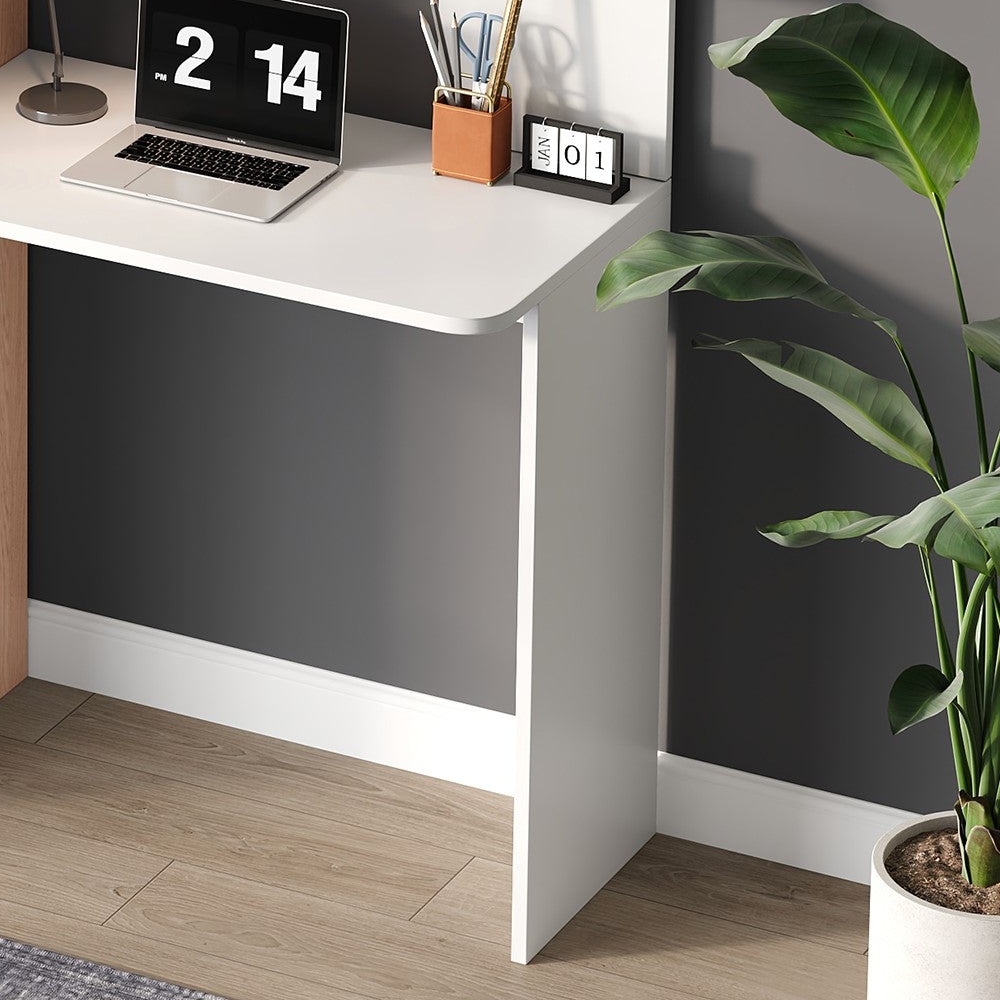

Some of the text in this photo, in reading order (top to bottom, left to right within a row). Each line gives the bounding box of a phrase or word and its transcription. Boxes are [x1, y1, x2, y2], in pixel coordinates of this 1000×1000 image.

[155, 26, 322, 112] PM 2 14
[537, 136, 551, 167] JAN
